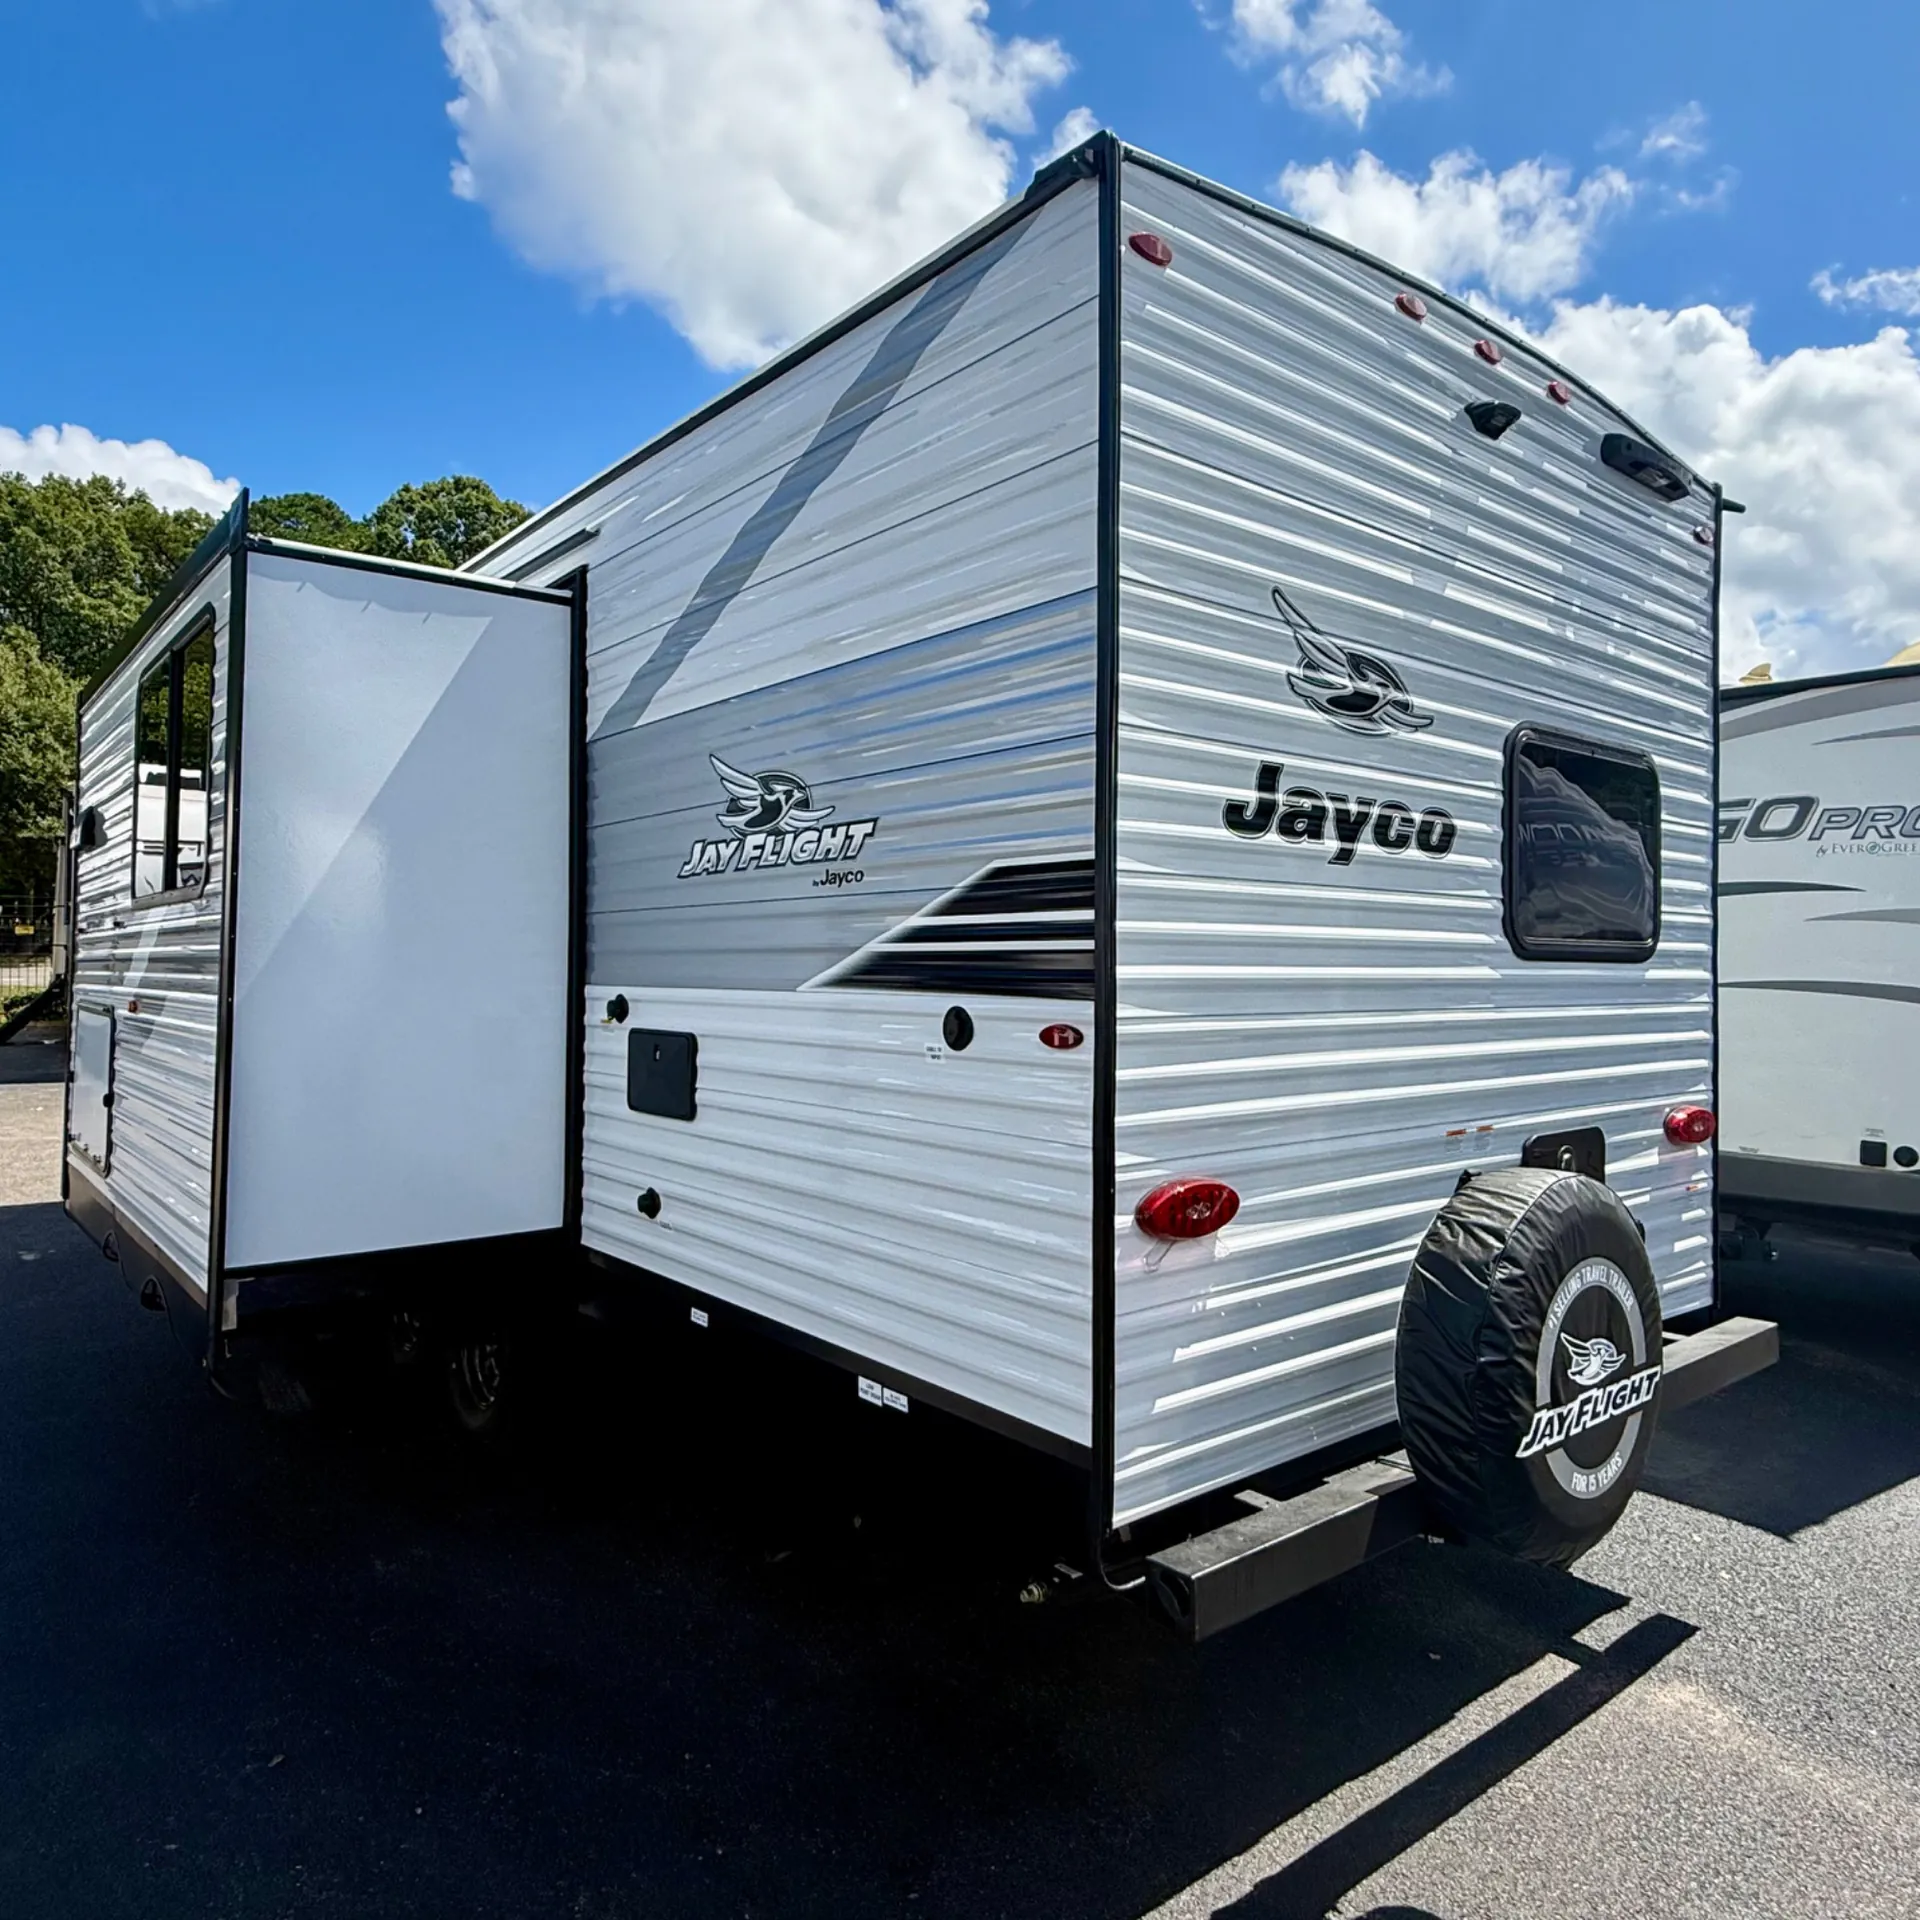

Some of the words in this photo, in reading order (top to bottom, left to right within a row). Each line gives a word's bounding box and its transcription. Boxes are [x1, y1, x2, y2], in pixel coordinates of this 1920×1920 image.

[1221, 760, 1457, 866] Jayco
[820, 868, 865, 888] Jayco
[1553, 1272, 1582, 1318] SELLING
[1581, 1265, 1608, 1284] TRAVEL
[1608, 1269, 1634, 1312] TRAILER
[1571, 1471, 1588, 1493] FOR
[1588, 1473, 1597, 1493] 15
[1597, 1451, 1622, 1488] YEARS
